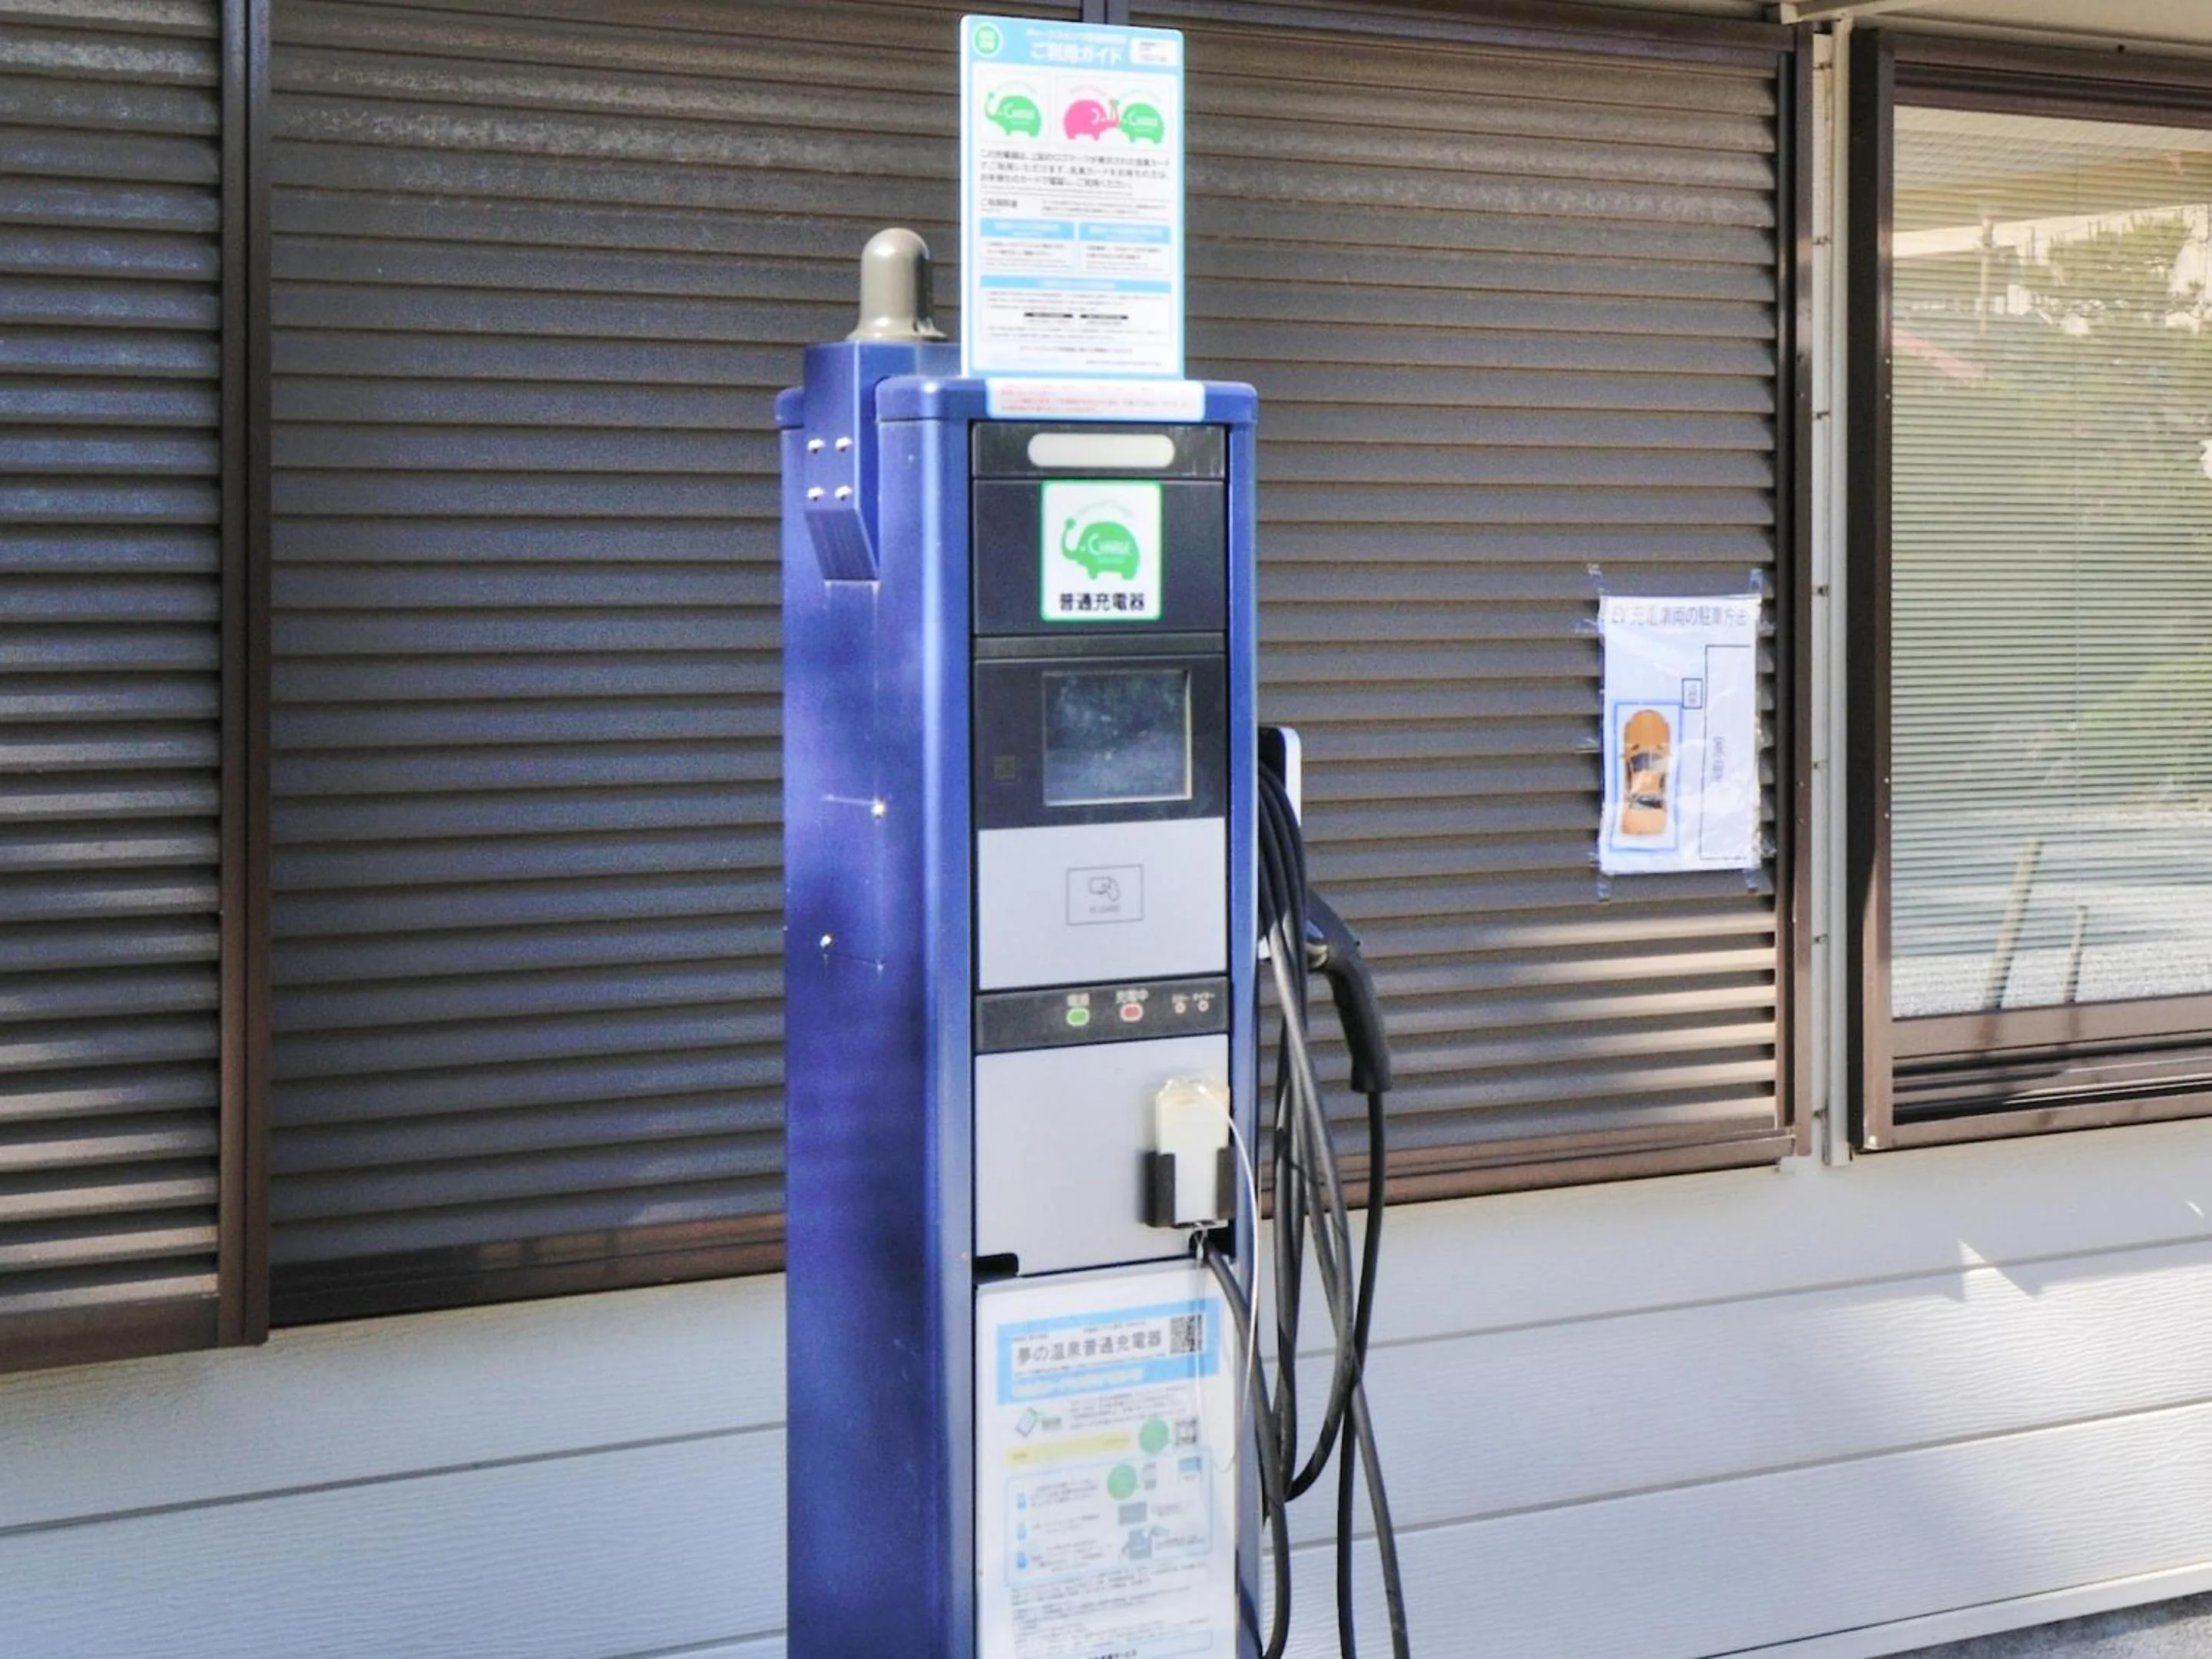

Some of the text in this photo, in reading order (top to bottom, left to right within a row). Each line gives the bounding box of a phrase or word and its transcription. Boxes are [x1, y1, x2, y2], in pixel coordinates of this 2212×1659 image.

[1060, 592, 1144, 611] 普通充電器
